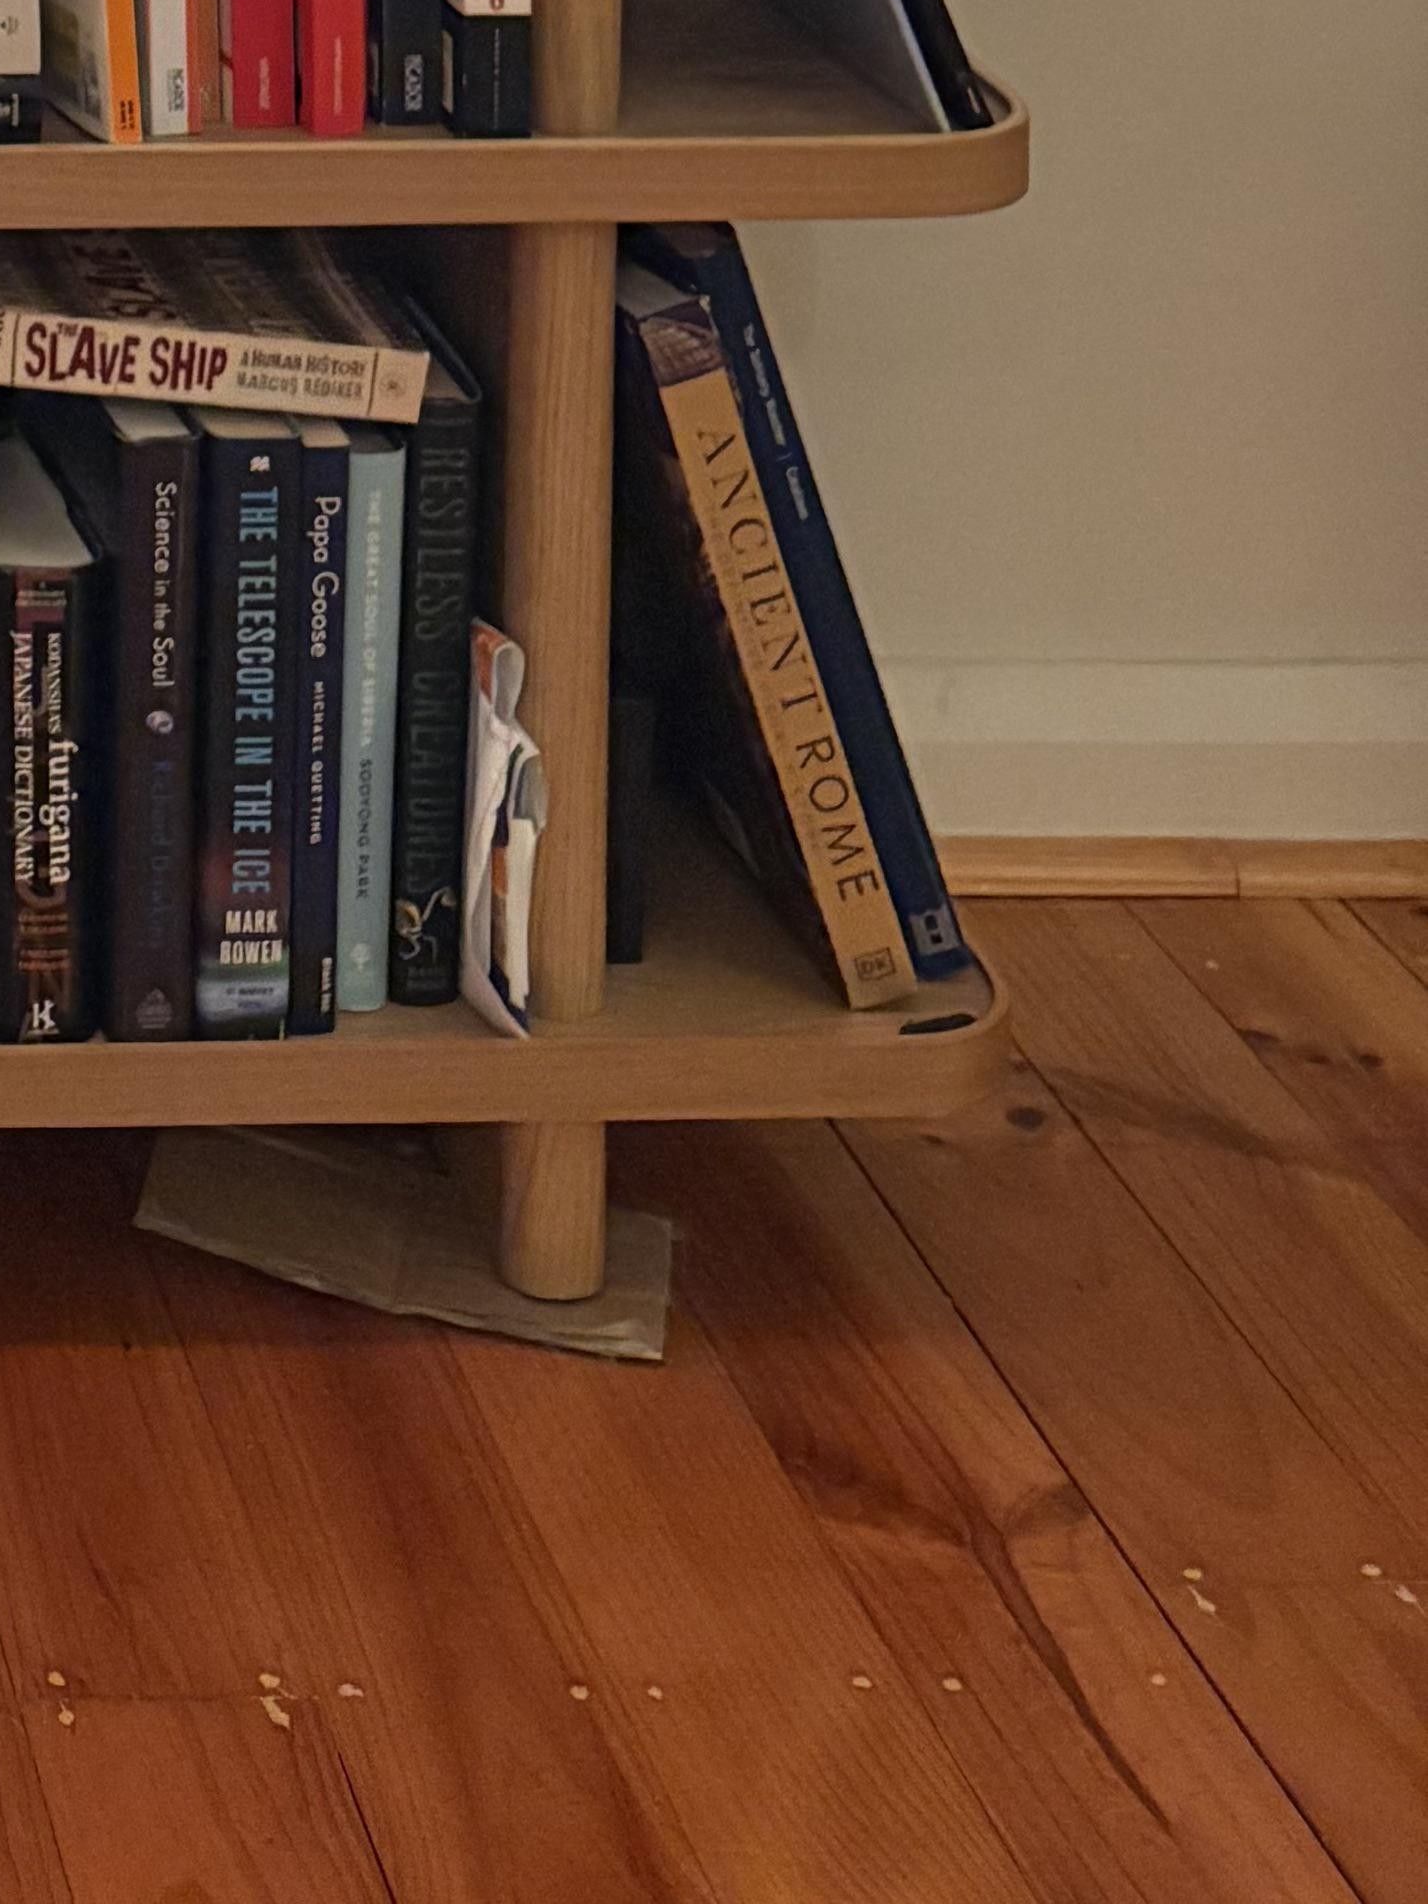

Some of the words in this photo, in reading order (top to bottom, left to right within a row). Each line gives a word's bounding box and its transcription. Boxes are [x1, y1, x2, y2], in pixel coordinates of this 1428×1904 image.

[24, 321, 137, 387] SLAVE
[148, 335, 228, 392] SHIP
[239, 487, 278, 544] THE
[307, 496, 342, 563] Papa
[236, 555, 277, 722] TELESCOPE
[310, 571, 339, 659] Goose
[695, 422, 825, 713] ANCIENT
[794, 737, 880, 902] ROME
[234, 736, 272, 765] IN
[38, 741, 78, 883] furigana
[234, 779, 272, 834] THE
[231, 851, 270, 894] ICE
[220, 939, 282, 965] BOWEN
[225, 910, 278, 935] MARK
